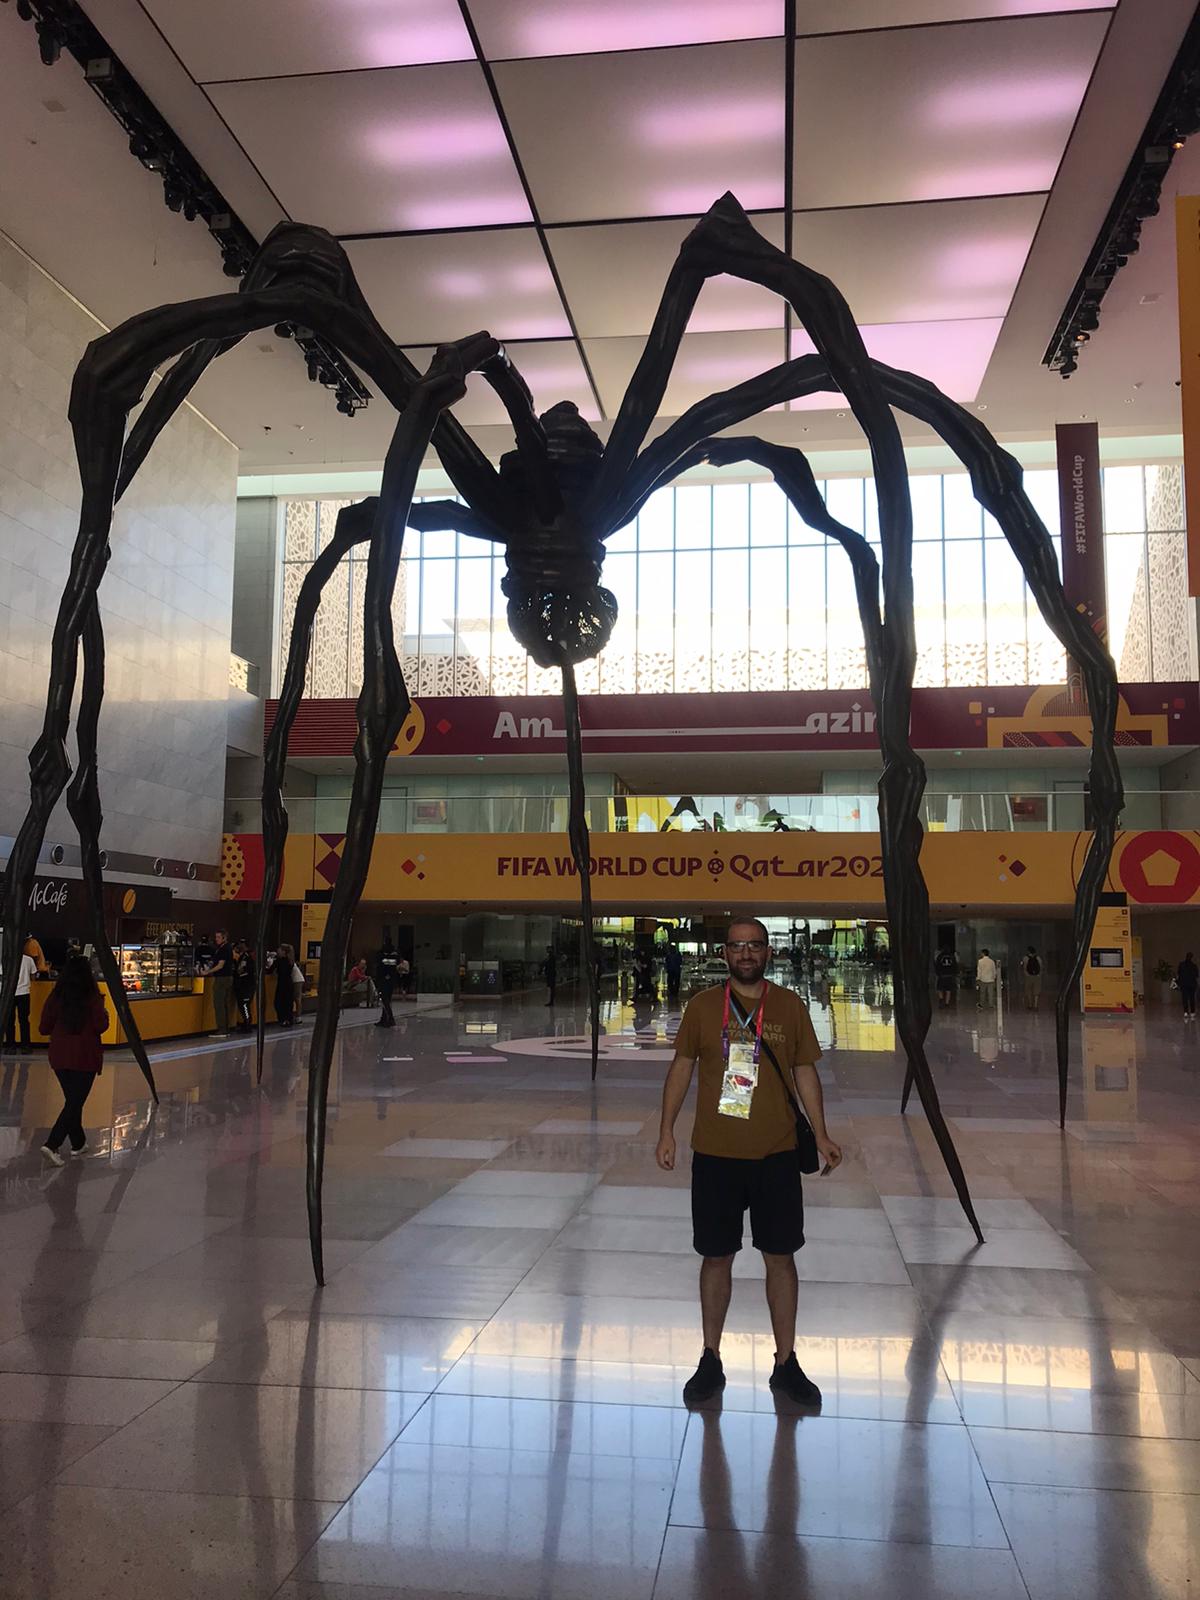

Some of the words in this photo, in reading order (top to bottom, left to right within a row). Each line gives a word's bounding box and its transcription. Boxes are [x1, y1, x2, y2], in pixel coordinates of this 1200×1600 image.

[1072, 454, 1087, 554] #FIFAWorldCup
[497, 857, 552, 876] FIFA
[652, 857, 703, 876] CUP
[729, 854, 885, 882] Qatar202
